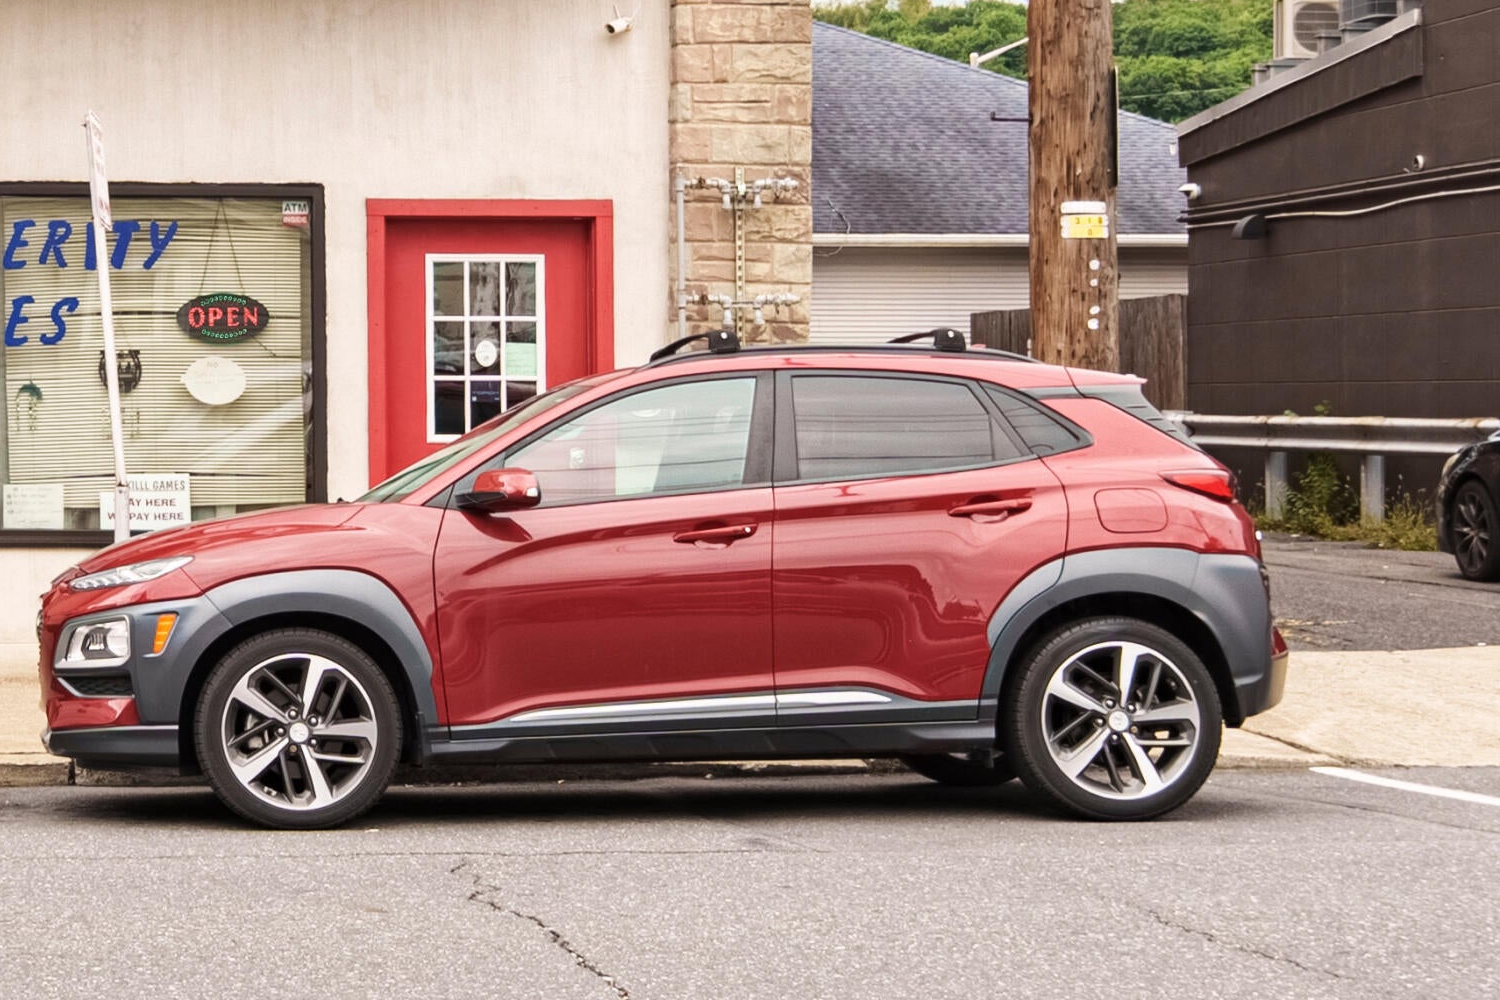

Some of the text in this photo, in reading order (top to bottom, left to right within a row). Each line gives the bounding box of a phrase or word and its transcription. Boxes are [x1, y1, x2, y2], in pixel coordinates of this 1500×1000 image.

[284, 202, 307, 212] ATM
[188, 306, 259, 328] OPEN
[153, 479, 186, 491] GAMES
[145, 498, 177, 507] HERE
[129, 512, 149, 521] PAY
[154, 511, 185, 520] HERE
